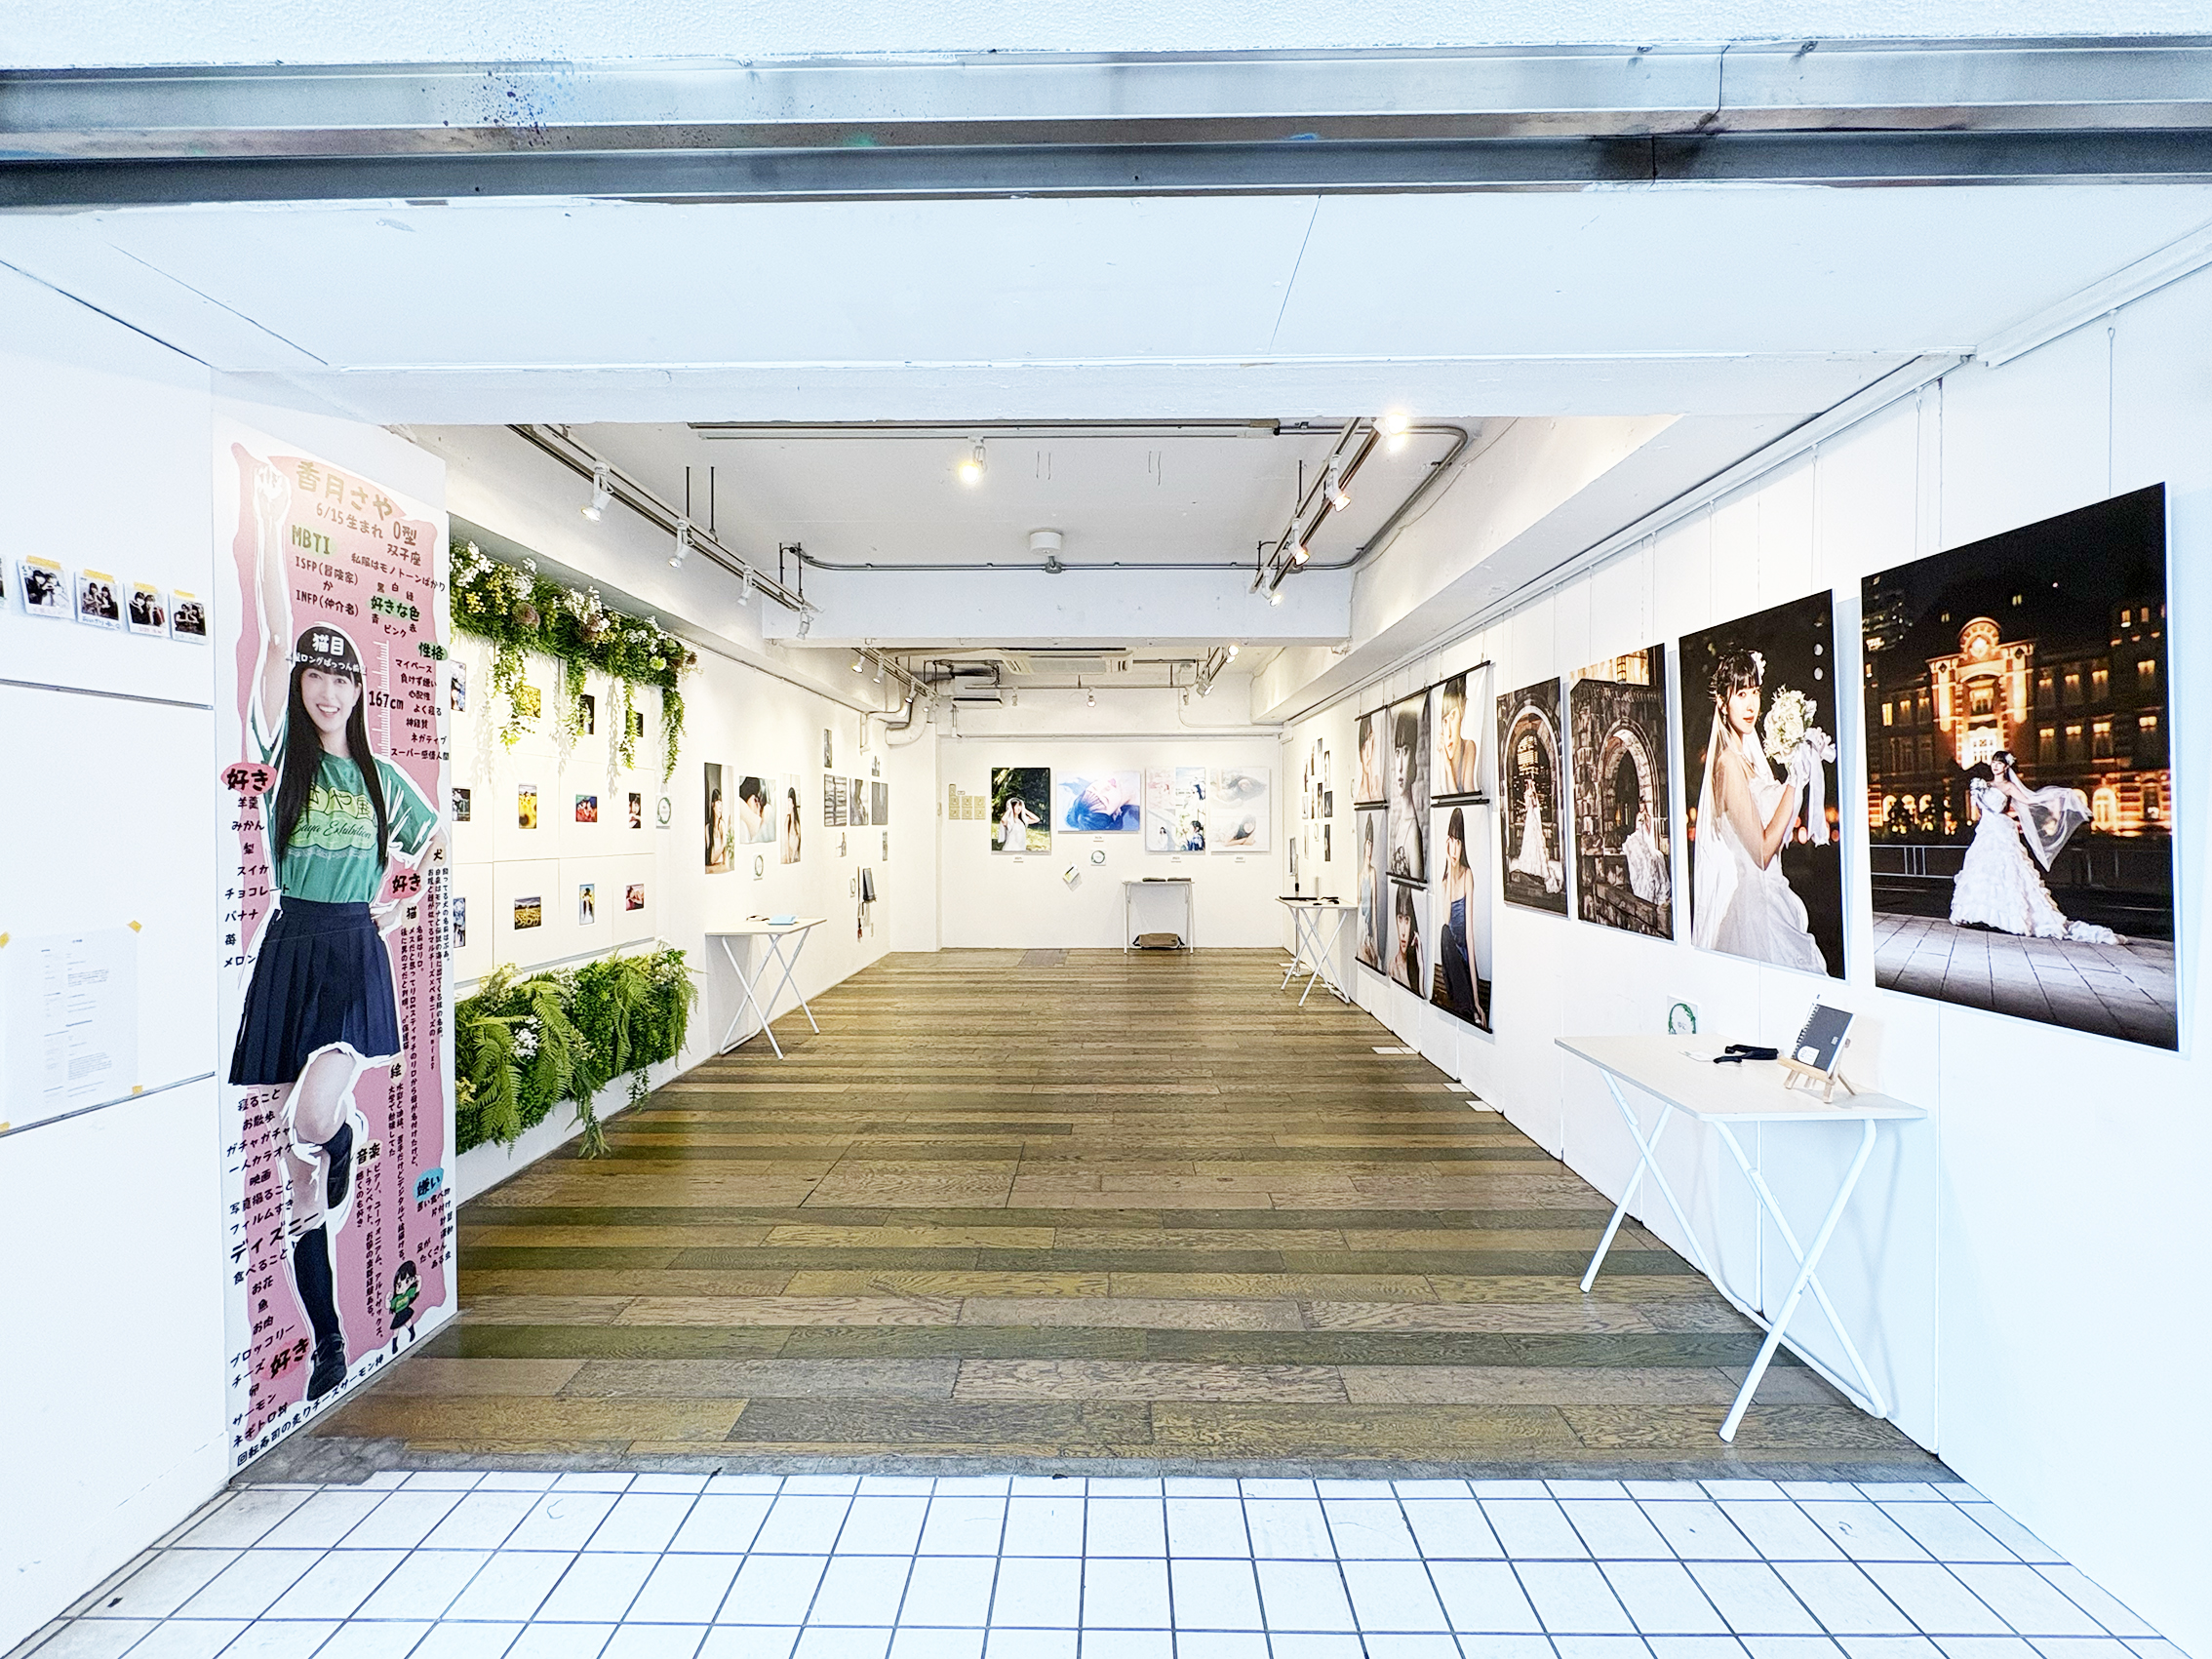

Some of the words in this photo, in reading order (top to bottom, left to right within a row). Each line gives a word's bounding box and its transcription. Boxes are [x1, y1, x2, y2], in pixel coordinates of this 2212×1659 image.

[296, 460, 393, 521] 香月さや
[317, 502, 383, 538] 6/15生まれ
[292, 524, 331, 555] MBTI
[387, 543, 421, 567] 双子座
[351, 552, 446, 592] 私服はモノトーンばかり
[323, 580, 334, 592] か
[391, 582, 399, 592] 白
[296, 589, 359, 617] INFP(仲介者)
[371, 595, 420, 622] 好きな色
[372, 613, 379, 624] 青
[384, 624, 407, 638] ピンク
[409, 623, 417, 634] 赤
[312, 633, 345, 656] 猫目
[418, 642, 445, 660] 性格
[395, 659, 432, 673] マイペース
[401, 673, 437, 688] 負けず嫌い
[369, 691, 404, 710] 167cm
[409, 691, 431, 701] 心配性
[414, 704, 442, 716] よく寝る
[406, 718, 429, 730] 神経質
[411, 732, 447, 744] ネガティブ
[226, 768, 269, 791] 好き
[231, 820, 265, 832] みかん
[243, 842, 255, 854] 梨
[433, 849, 443, 861] 犬
[237, 864, 269, 877] スイカ
[224, 884, 290, 899] チョコレート
[392, 873, 420, 893] 好き
[224, 909, 258, 923] バナナ
[407, 906, 417, 920] 猫
[225, 933, 237, 946] 苺
[223, 955, 257, 968] メロン
[237, 1088, 280, 1112] 寝ること
[243, 1110, 276, 1131] お散歩
[226, 1126, 291, 1158] ガチャガチャ
[228, 1143, 294, 1173] 一人カラオケ
[356, 1143, 380, 1165] 音楽
[249, 1168, 272, 1186] 映画
[417, 1175, 441, 1198] 嫌い
[230, 1179, 294, 1215] 写真撮ること
[230, 1212, 319, 1264] ディズニー
[233, 1248, 289, 1285] 食べること
[252, 1275, 274, 1296] お花
[257, 1298, 268, 1313] 魚
[253, 1316, 274, 1335] お肉
[230, 1324, 296, 1368] ブロッコリー
[270, 1338, 309, 1379] 好き
[232, 1358, 265, 1389] チーズ
[249, 1382, 259, 1398] 卵
[233, 1394, 277, 1426] サーモン
[232, 1402, 288, 1448] ネギトロ丼
